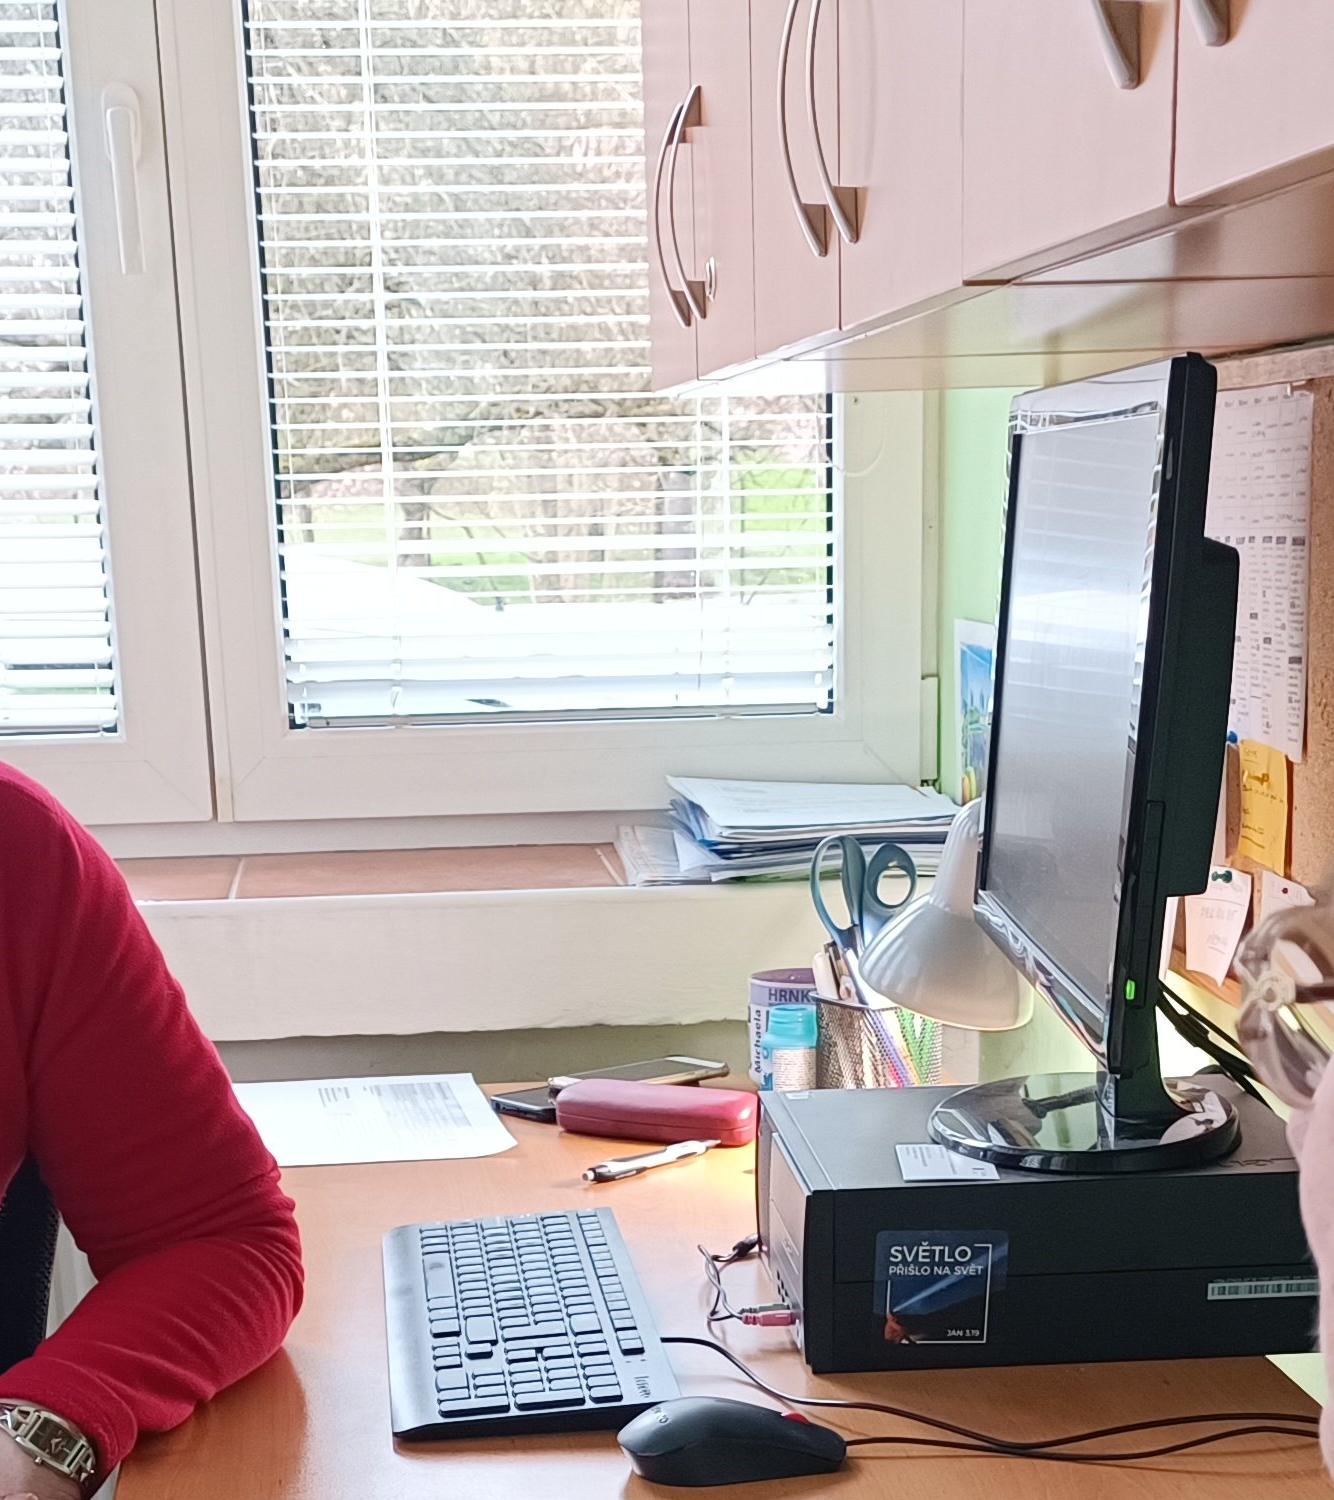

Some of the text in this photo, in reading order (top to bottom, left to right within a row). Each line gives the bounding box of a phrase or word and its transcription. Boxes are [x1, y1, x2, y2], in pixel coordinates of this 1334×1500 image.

[768, 988, 814, 1003] HRNK
[889, 1241, 972, 1262] SVĚTLO
[888, 1263, 984, 1276] PŘIŠLO NA SVĚT
[946, 1329, 964, 1337] JAN
